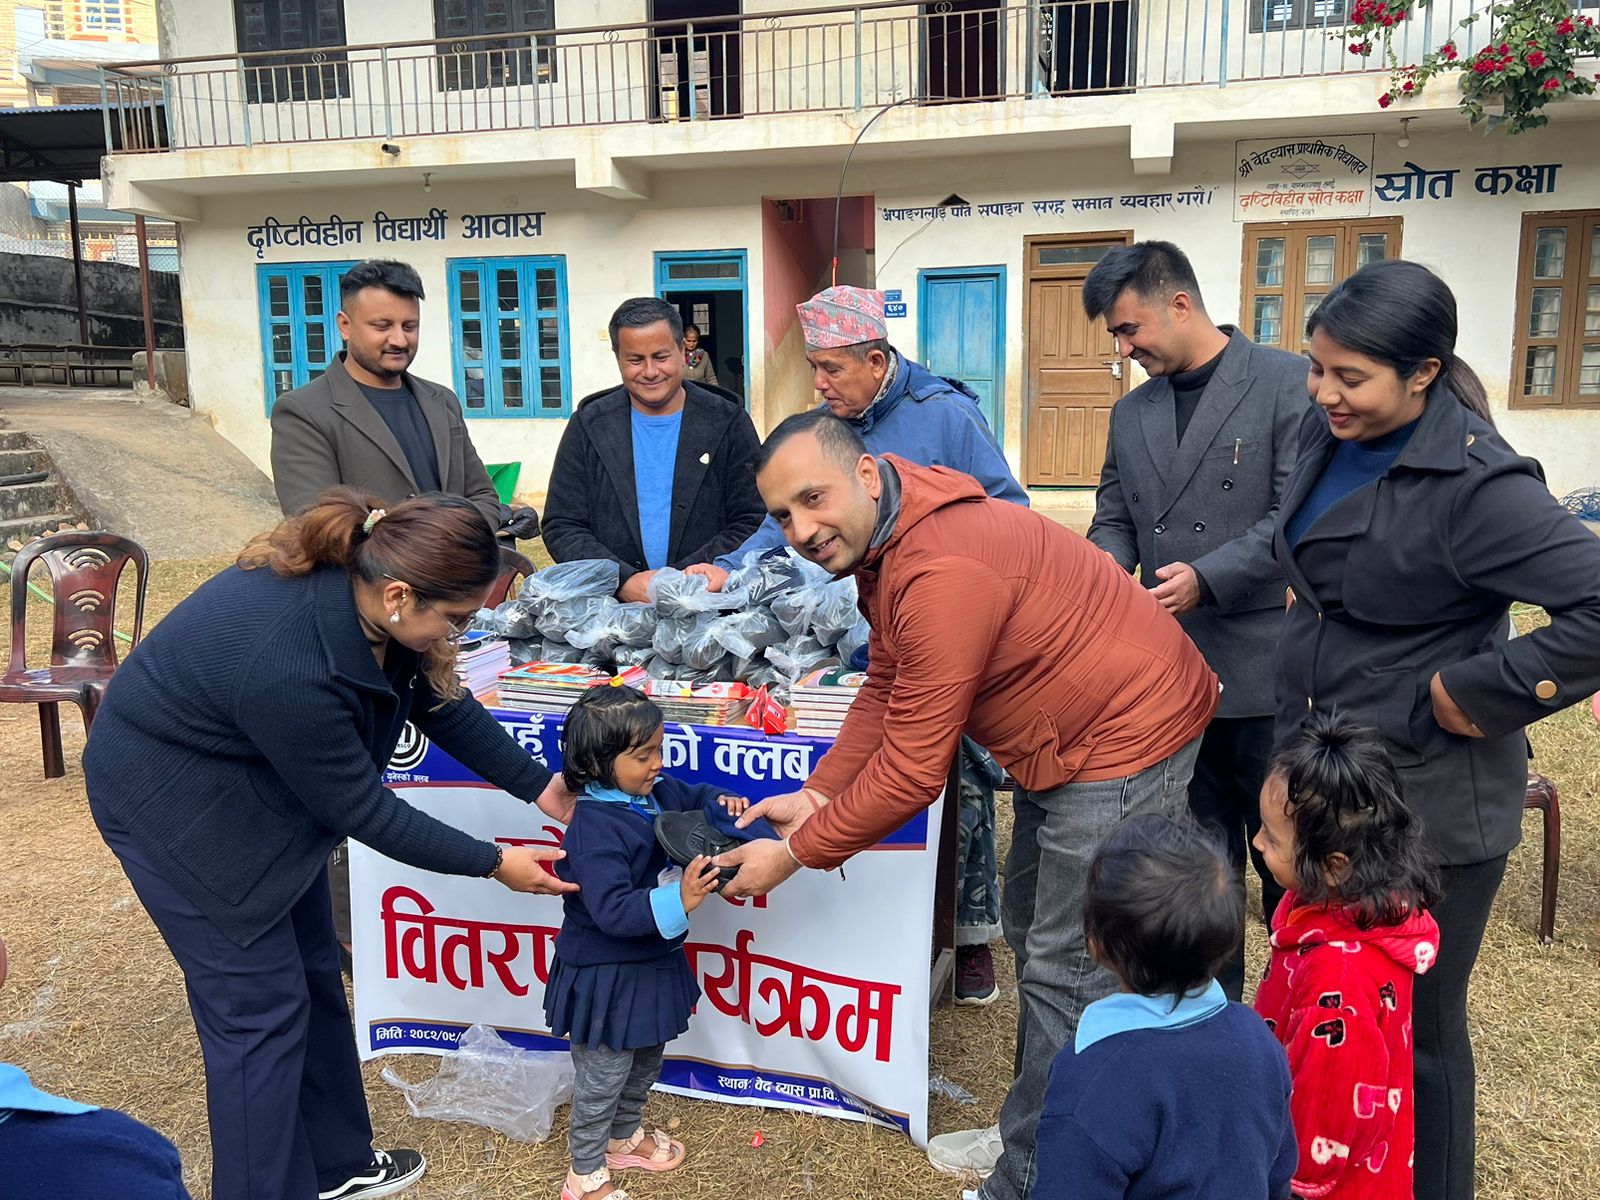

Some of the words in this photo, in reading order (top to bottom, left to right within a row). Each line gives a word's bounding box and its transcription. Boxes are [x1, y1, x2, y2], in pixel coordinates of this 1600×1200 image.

[1238, 158, 1254, 178] श्री
[1295, 139, 1337, 158] प्राथमिक
[1333, 143, 1369, 175] विद्यालय
[1334, 189, 1365, 205] कक्षा
[1374, 161, 1461, 202] स्रोत
[1474, 163, 1563, 196] कक्षा
[1031, 199, 1066, 219] सरह
[1120, 192, 1176, 213] व्यवहार
[246, 214, 364, 260] दृष्टिविहीन
[373, 207, 449, 243] विद्यार्थी
[460, 211, 547, 240] आवास
[713, 737, 813, 782] क्लब
[754, 1076, 773, 1093] वेद
[775, 1081, 806, 1097] व्यास
